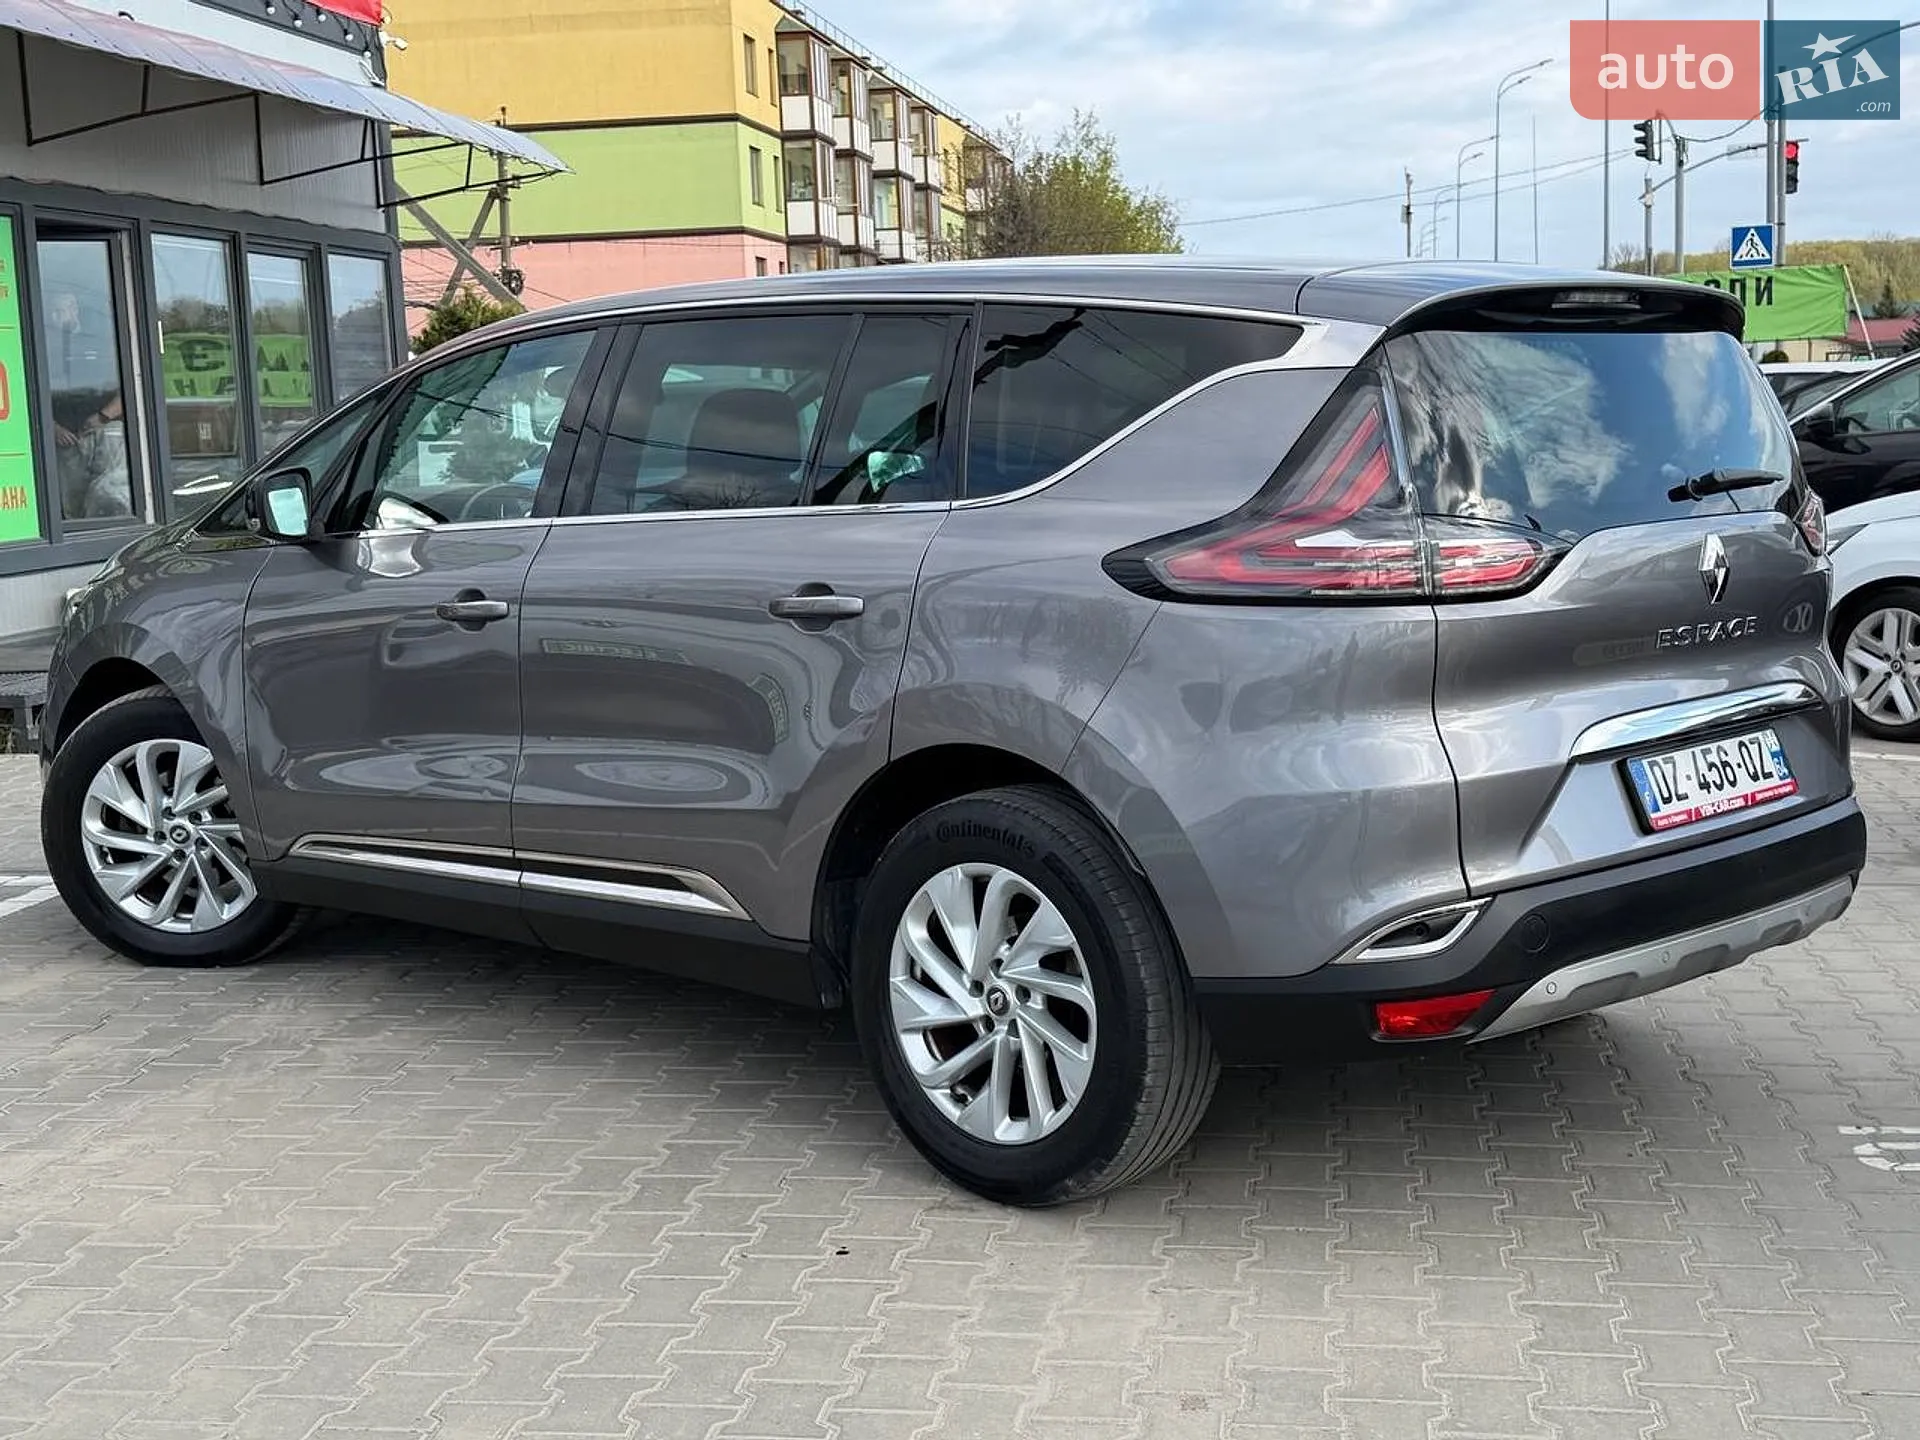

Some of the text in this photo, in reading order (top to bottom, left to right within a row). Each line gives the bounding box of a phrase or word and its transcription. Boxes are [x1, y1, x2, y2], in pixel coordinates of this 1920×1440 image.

[0, 486, 27, 509] АНА
[1656, 616, 1758, 649] ESPACE
[936, 819, 1025, 851] Continental
